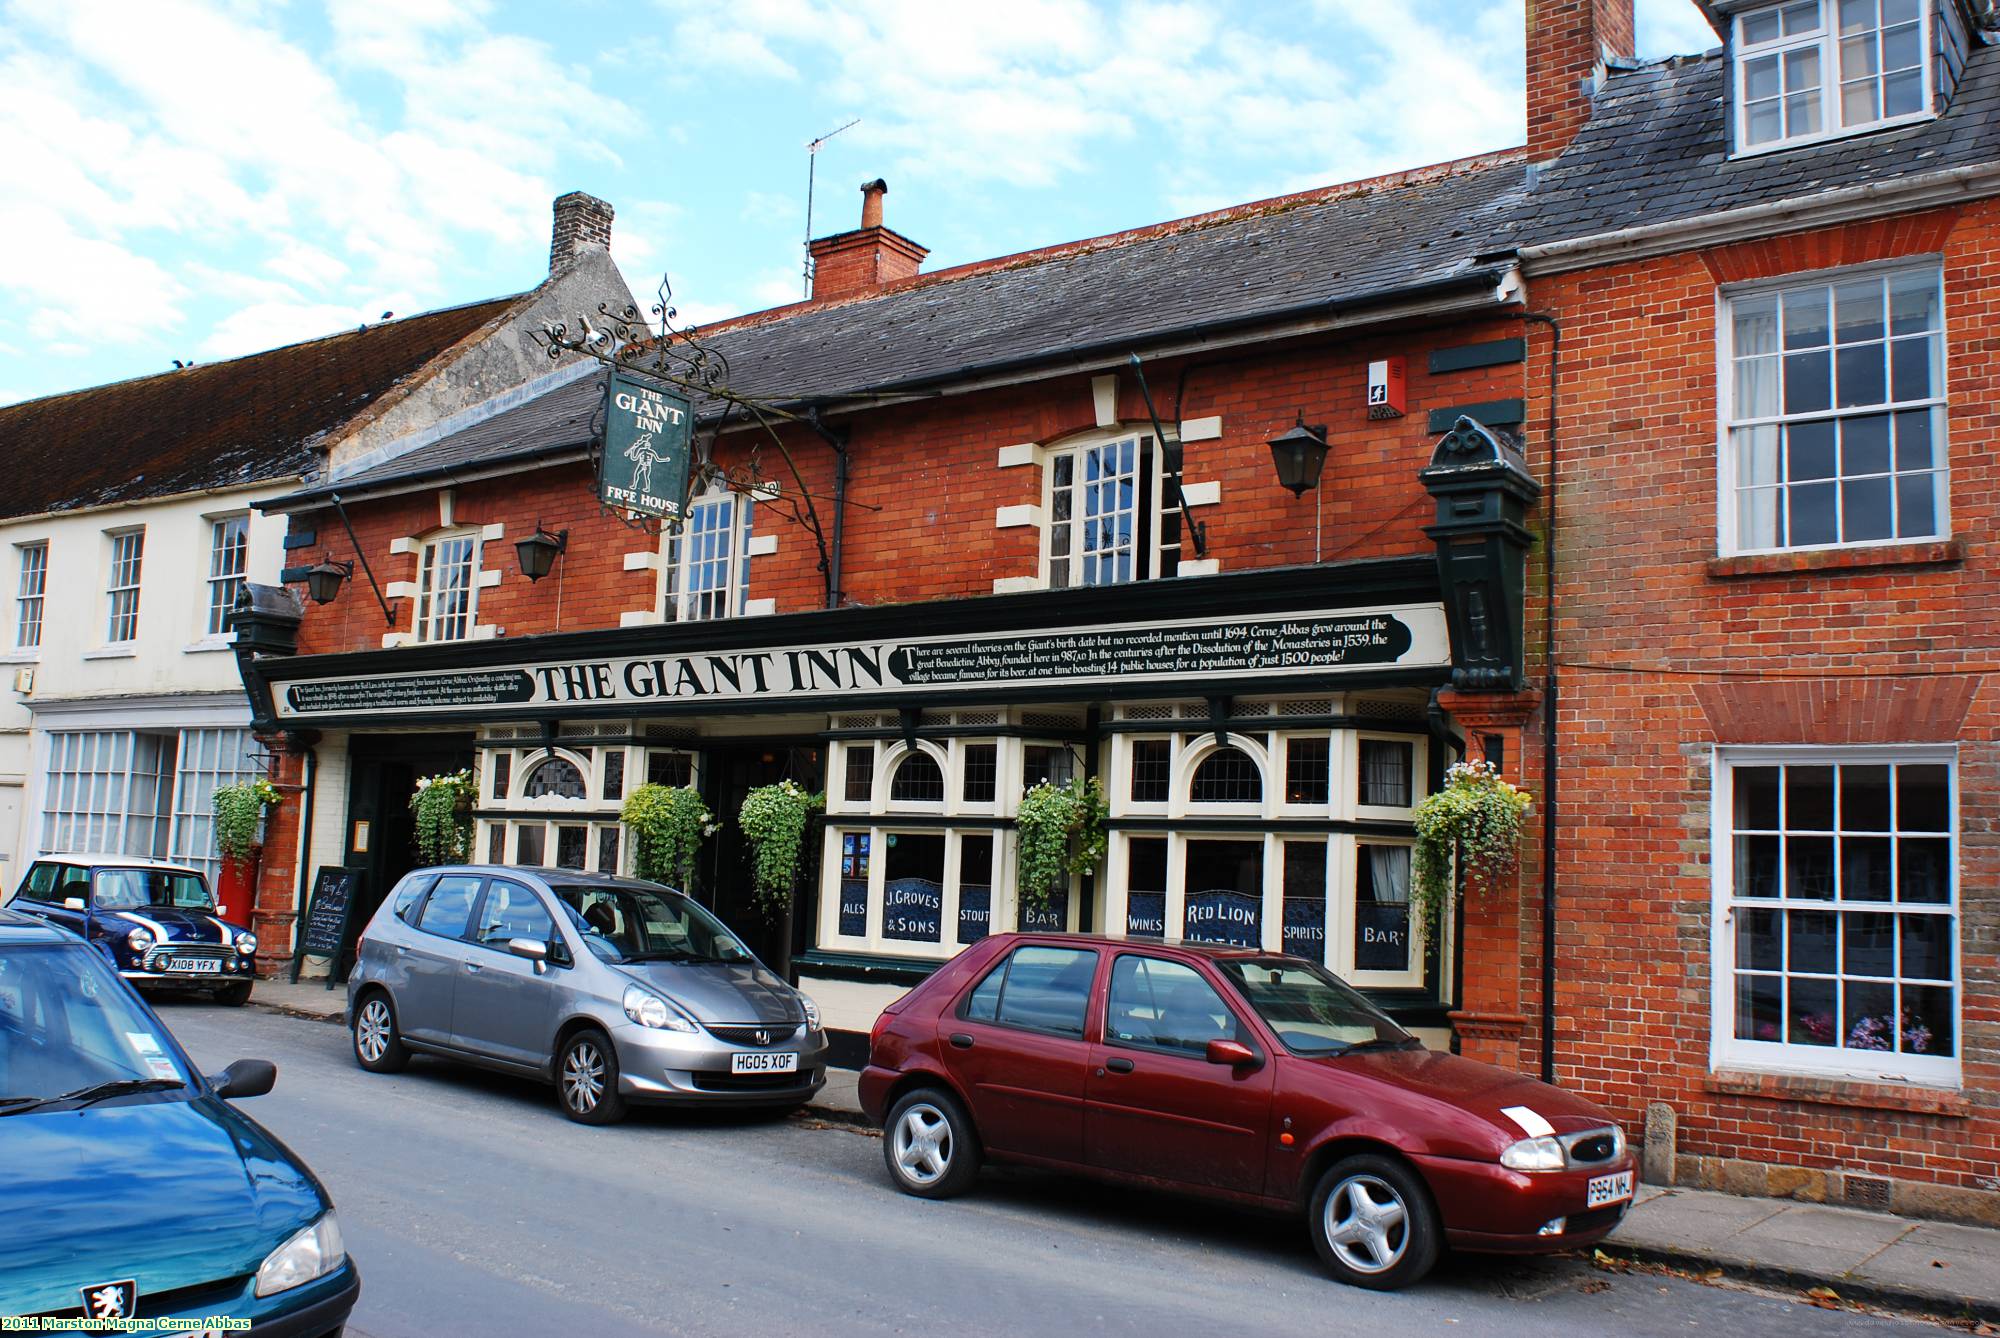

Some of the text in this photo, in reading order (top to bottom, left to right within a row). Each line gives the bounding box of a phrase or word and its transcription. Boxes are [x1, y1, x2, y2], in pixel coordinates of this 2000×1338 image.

[641, 388, 663, 403] THE
[615, 393, 684, 425] GIANT
[636, 416, 663, 434] INN
[607, 486, 679, 513] FREE HOUSE
[946, 644, 970, 655] several
[972, 643, 1002, 653] theories
[1015, 641, 1026, 651] the
[1028, 640, 1055, 653] Giant's
[1056, 636, 1076, 648] birth
[1078, 637, 1096, 647] date
[1097, 636, 1112, 646] but
[1114, 637, 1123, 645] no
[1126, 632, 1162, 644] recorded
[1164, 631, 1199, 642] mention
[1201, 628, 1222, 640] until
[1250, 626, 1278, 637] Cerne
[1278, 623, 1310, 637] Abbas
[1311, 624, 1333, 636] grew
[1334, 619, 1369, 631] around
[1371, 619, 1387, 630] the
[917, 659, 935, 670] great
[936, 656, 975, 667] Benedictine
[1033, 652, 1050, 663] here
[1052, 652, 1060, 662] in
[1099, 649, 1112, 659] the
[1114, 648, 1153, 658] centuries
[1155, 645, 1176, 658] after
[1178, 644, 1191, 655] the
[1193, 643, 1241, 654] Dissolution
[1243, 639, 1253, 653] of
[1254, 639, 1268, 651] the
[1271, 639, 1331, 652] Monasteries
[1332, 638, 1342, 647] in
[1372, 633, 1388, 644] the
[536, 645, 884, 702] THE GIANT INN
[909, 672, 930, 683] village
[931, 671, 958, 680] became
[957, 669, 985, 681] famous
[985, 668, 998, 680] for
[999, 668, 1009, 677] its
[1028, 667, 1037, 676] at
[1038, 667, 1053, 675] one
[1055, 665, 1072, 674] time
[1073, 663, 1106, 675] boasting
[1107, 661, 1117, 673] 14
[1120, 660, 1144, 673] public
[1146, 658, 1174, 669] houses
[1174, 656, 1189, 670] for
[1191, 660, 1197, 668] a
[1199, 656, 1246, 670] population
[1248, 654, 1259, 668] of
[1259, 654, 1279, 667] just
[1281, 651, 1310, 665] 1500
[1310, 649, 1345, 665] people!
[843, 903, 865, 914] ALES
[960, 909, 989, 922] STOUT
[1026, 908, 1058, 927] BAR
[1188, 903, 1255, 925] RED LION
[888, 919, 895, 931] &
[1128, 914, 1163, 931] WINES
[1284, 926, 1323, 940] SPIRITS
[1364, 927, 1399, 946] BAR
[171, 960, 215, 970] X108 YFX
[737, 1055, 792, 1069] HG05 XOF
